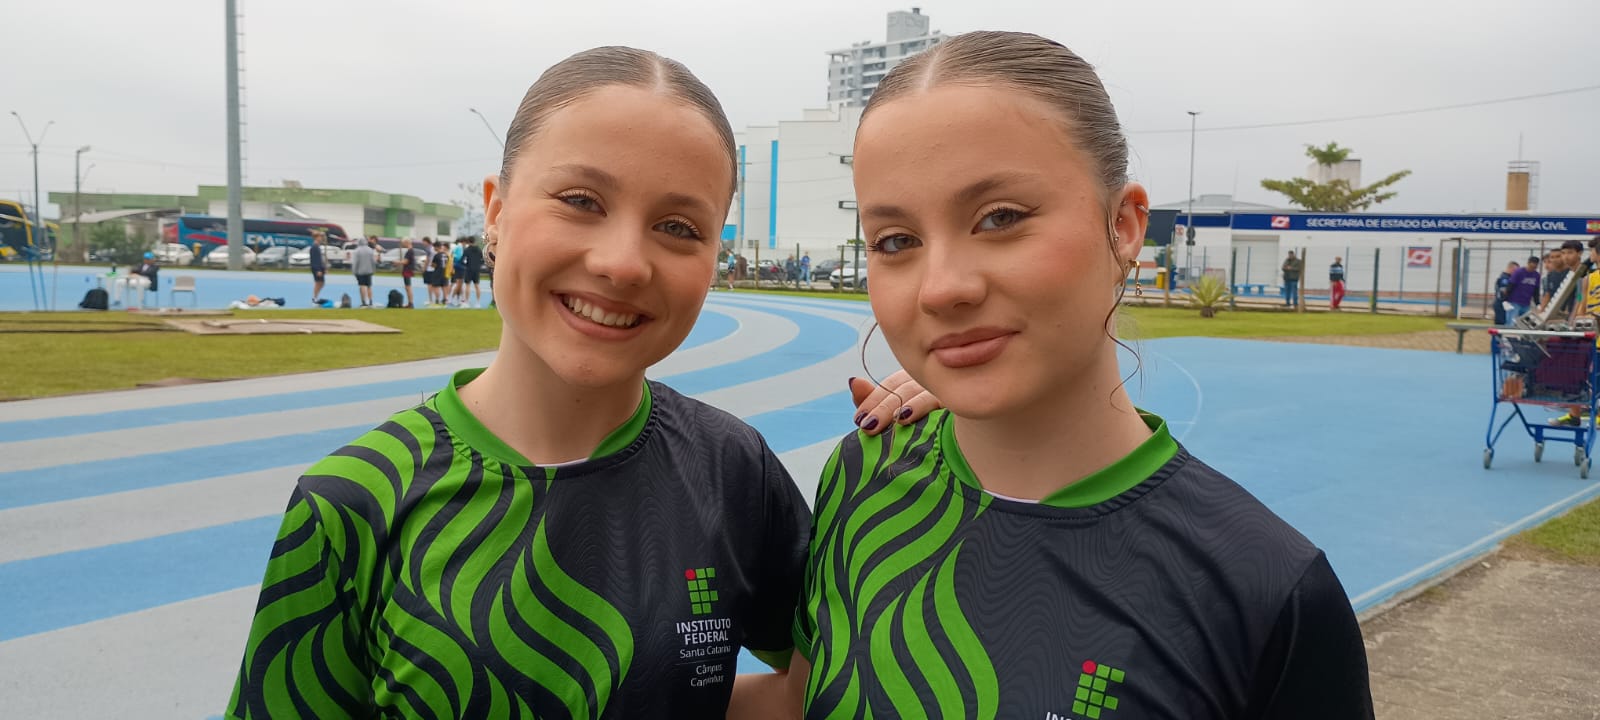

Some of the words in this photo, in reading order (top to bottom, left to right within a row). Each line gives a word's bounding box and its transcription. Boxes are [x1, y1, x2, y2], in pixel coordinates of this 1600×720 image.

[1306, 218, 1364, 228] SECRETARIA
[1365, 218, 1380, 228] DE
[1381, 219, 1420, 228] ESTADO
[1421, 219, 1437, 228] DA
[1438, 218, 1492, 231] PROTEÇÃO
[1494, 220, 1501, 229] E
[1502, 220, 1541, 230] DEFESA
[1542, 221, 1568, 231] CIVIL
[676, 618, 731, 634] INSTITUTO
[684, 630, 728, 645] FEDERAL
[680, 648, 705, 659] Santa
